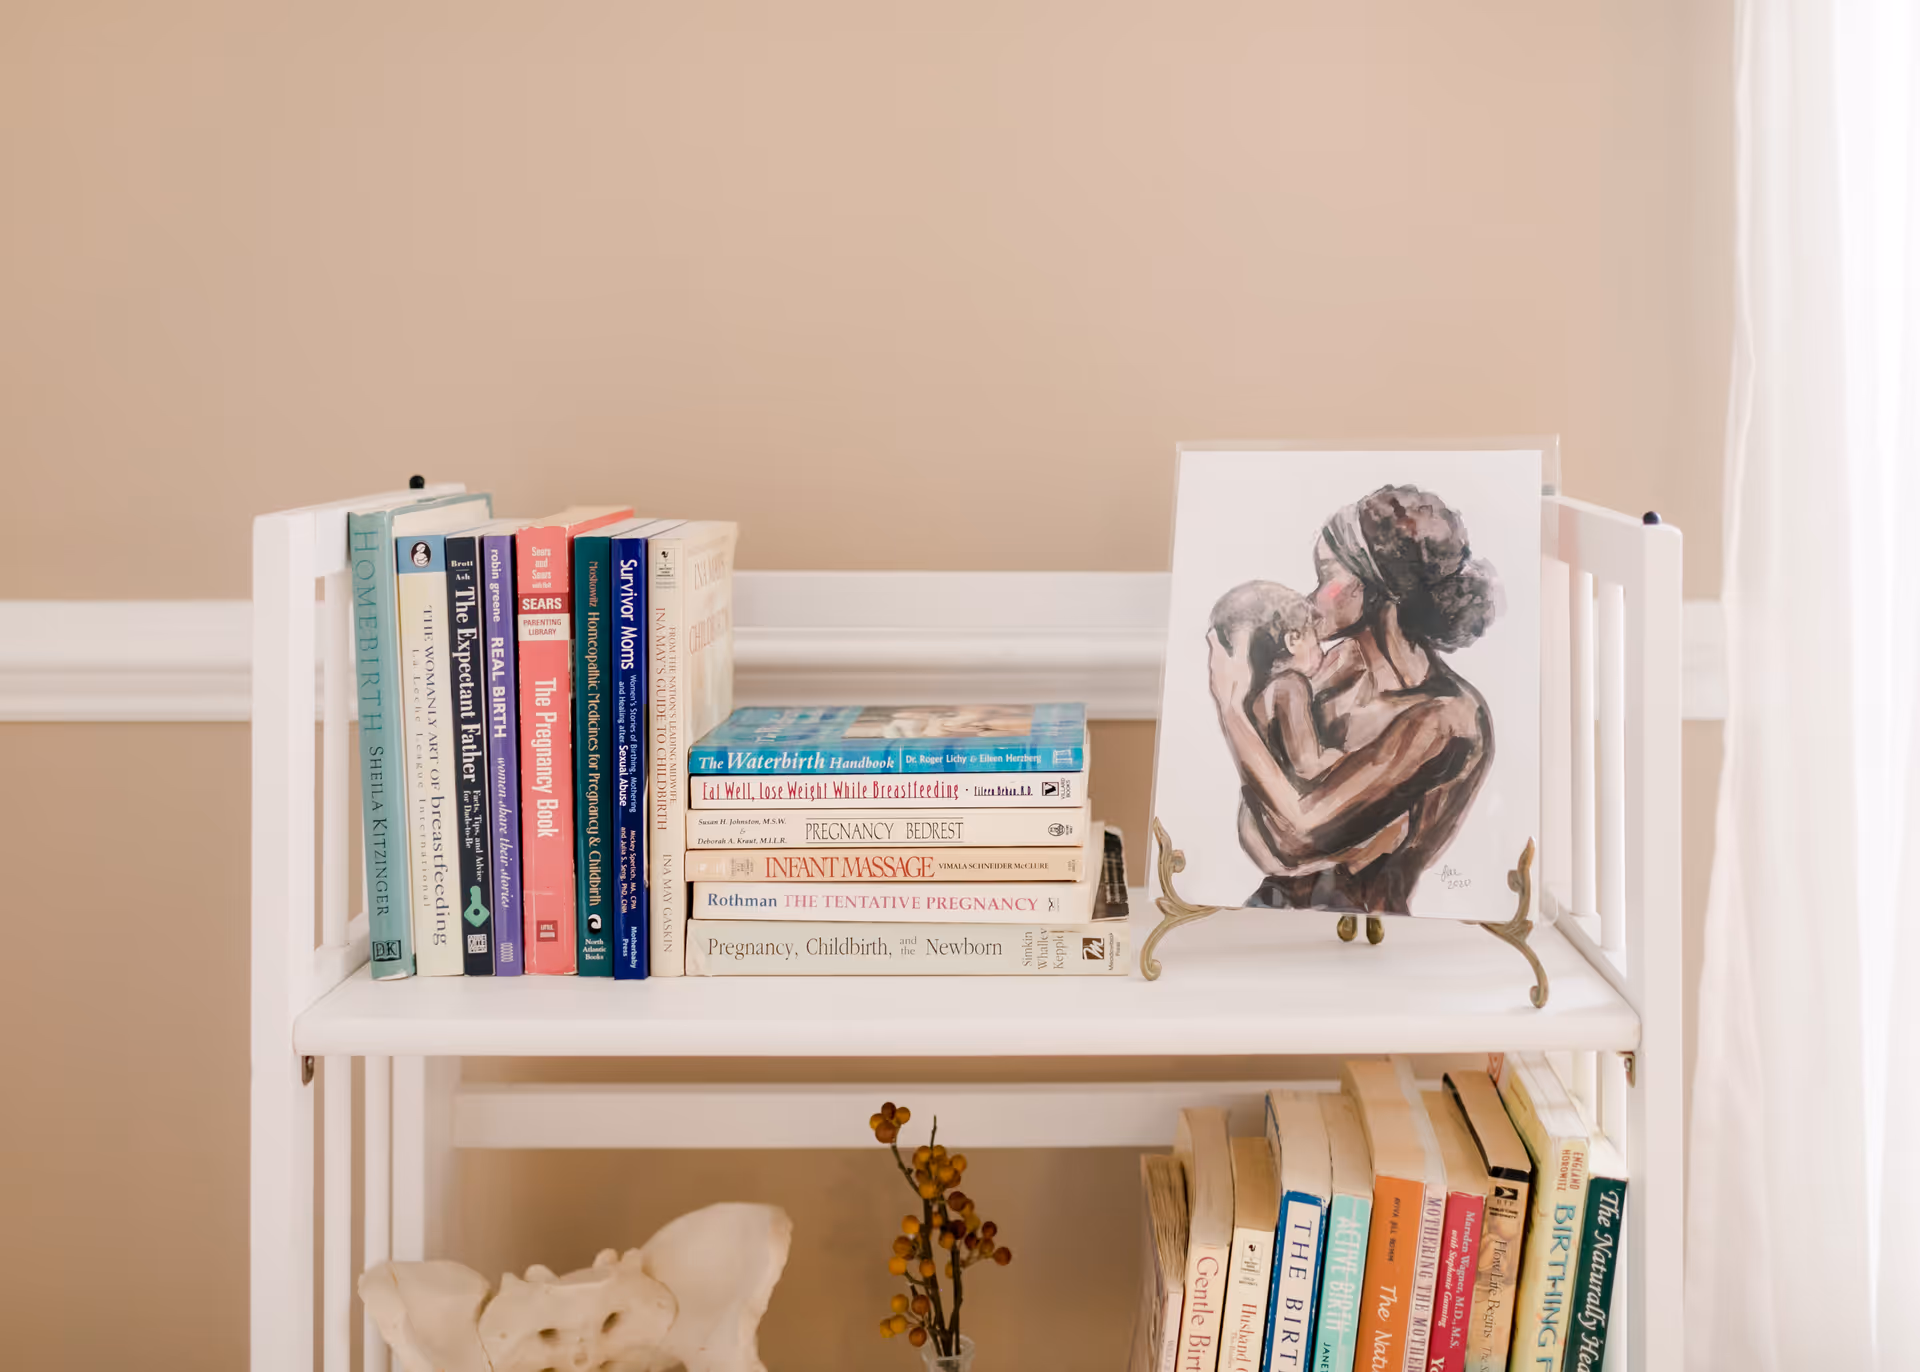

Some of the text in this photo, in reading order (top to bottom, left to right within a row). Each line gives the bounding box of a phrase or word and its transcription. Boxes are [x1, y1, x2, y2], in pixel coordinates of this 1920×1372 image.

[451, 559, 473, 568] Brott
[531, 547, 552, 557] Sears
[535, 558, 549, 568] and
[455, 573, 471, 581] Ash
[488, 548, 501, 623] robin greene
[531, 570, 552, 580] Sears
[522, 598, 563, 611] SEARS
[523, 618, 562, 627] PARENTING
[620, 559, 638, 670] Survivor Moms
[528, 627, 558, 637] LIBRARY
[668, 626, 676, 653] FROM
[585, 611, 601, 691] Homeopathic
[452, 586, 482, 783] The Expectant Father
[490, 636, 508, 738] REAL BIRTH
[618, 681, 626, 695] and
[668, 676, 677, 718] NATION'S
[353, 530, 390, 916] HOMEBIRTH SHEILA KITZINGER
[587, 694, 601, 751] Medicines
[617, 696, 626, 724] Healing
[655, 607, 668, 830] INA MAY'S GUIDE TO CHILDBIRTH
[531, 677, 560, 838] The Pregnancy Book
[629, 674, 638, 813] Women's Stories of Birthing, Mothering
[669, 719, 677, 761] LEADING
[423, 604, 451, 946] THE WOMANLY ART OF breastfeeding
[588, 753, 601, 771] for
[619, 745, 629, 775] Sexual
[699, 751, 895, 770] The Waterbirth Handbook
[905, 753, 1042, 765] Dr. Roger Lichy Eileen Herzberg
[463, 790, 472, 802] for
[619, 777, 629, 807] Abuse
[669, 762, 677, 806] MIDWIFE
[703, 779, 959, 801] Eat Well, Lose Weight While Breastfeeding
[585, 773, 602, 835] Pregnancy
[698, 818, 719, 826] Susan
[729, 818, 761, 826] Johnston,
[475, 836, 484, 854] and
[497, 757, 515, 909] women share their stories
[588, 836, 602, 849] &
[620, 827, 628, 839] and
[628, 830, 637, 852] Mickey
[697, 837, 726, 845] Deborah
[805, 822, 964, 840] PREGNANCY BEDREST
[418, 799, 431, 907] International
[476, 855, 485, 882] Advice
[765, 856, 1049, 878] INFANT MASSAGE VIMALA SCHNEIDER McCLURE
[588, 851, 602, 907] Childbirth
[1447, 879, 1471, 890] 2020
[662, 854, 673, 953] INA MAY GASKIN
[708, 893, 778, 907] Rothman
[784, 894, 818, 908] THE
[823, 895, 921, 910] TENTATIVE
[926, 896, 1039, 911] PREGNANCY
[585, 953, 604, 961] Books
[622, 938, 630, 957] Press
[630, 926, 639, 969] Motherbaby
[708, 937, 893, 961] Pregnancy, Childbirth,
[899, 935, 917, 945] and
[900, 946, 916, 955] the
[925, 937, 1003, 956] Newborn
[1021, 930, 1033, 967] Simkin
[1037, 927, 1049, 970] Whalley
[1556, 1149, 1572, 1192] HOROWITZ
[1569, 1151, 1585, 1191] ENGLAND
[1288, 1220, 1313, 1280] THE
[1333, 1216, 1361, 1275] ACTIVE
[1413, 1197, 1443, 1313] MOTHERING THE
[1577, 1190, 1620, 1332] The Naturally
[1191, 1256, 1220, 1326] Gentle
[1438, 1229, 1458, 1329] with Stephanie Gunning
[1449, 1210, 1476, 1349] Marsden Wagner, M.D., M.S.
[1483, 1239, 1508, 1339] How Life Begins
[1536, 1201, 1578, 1348] BIRTHING
[1325, 1280, 1356, 1333] BIRTH
[1377, 1285, 1398, 1323] The
[1236, 1303, 1258, 1363] Husband
